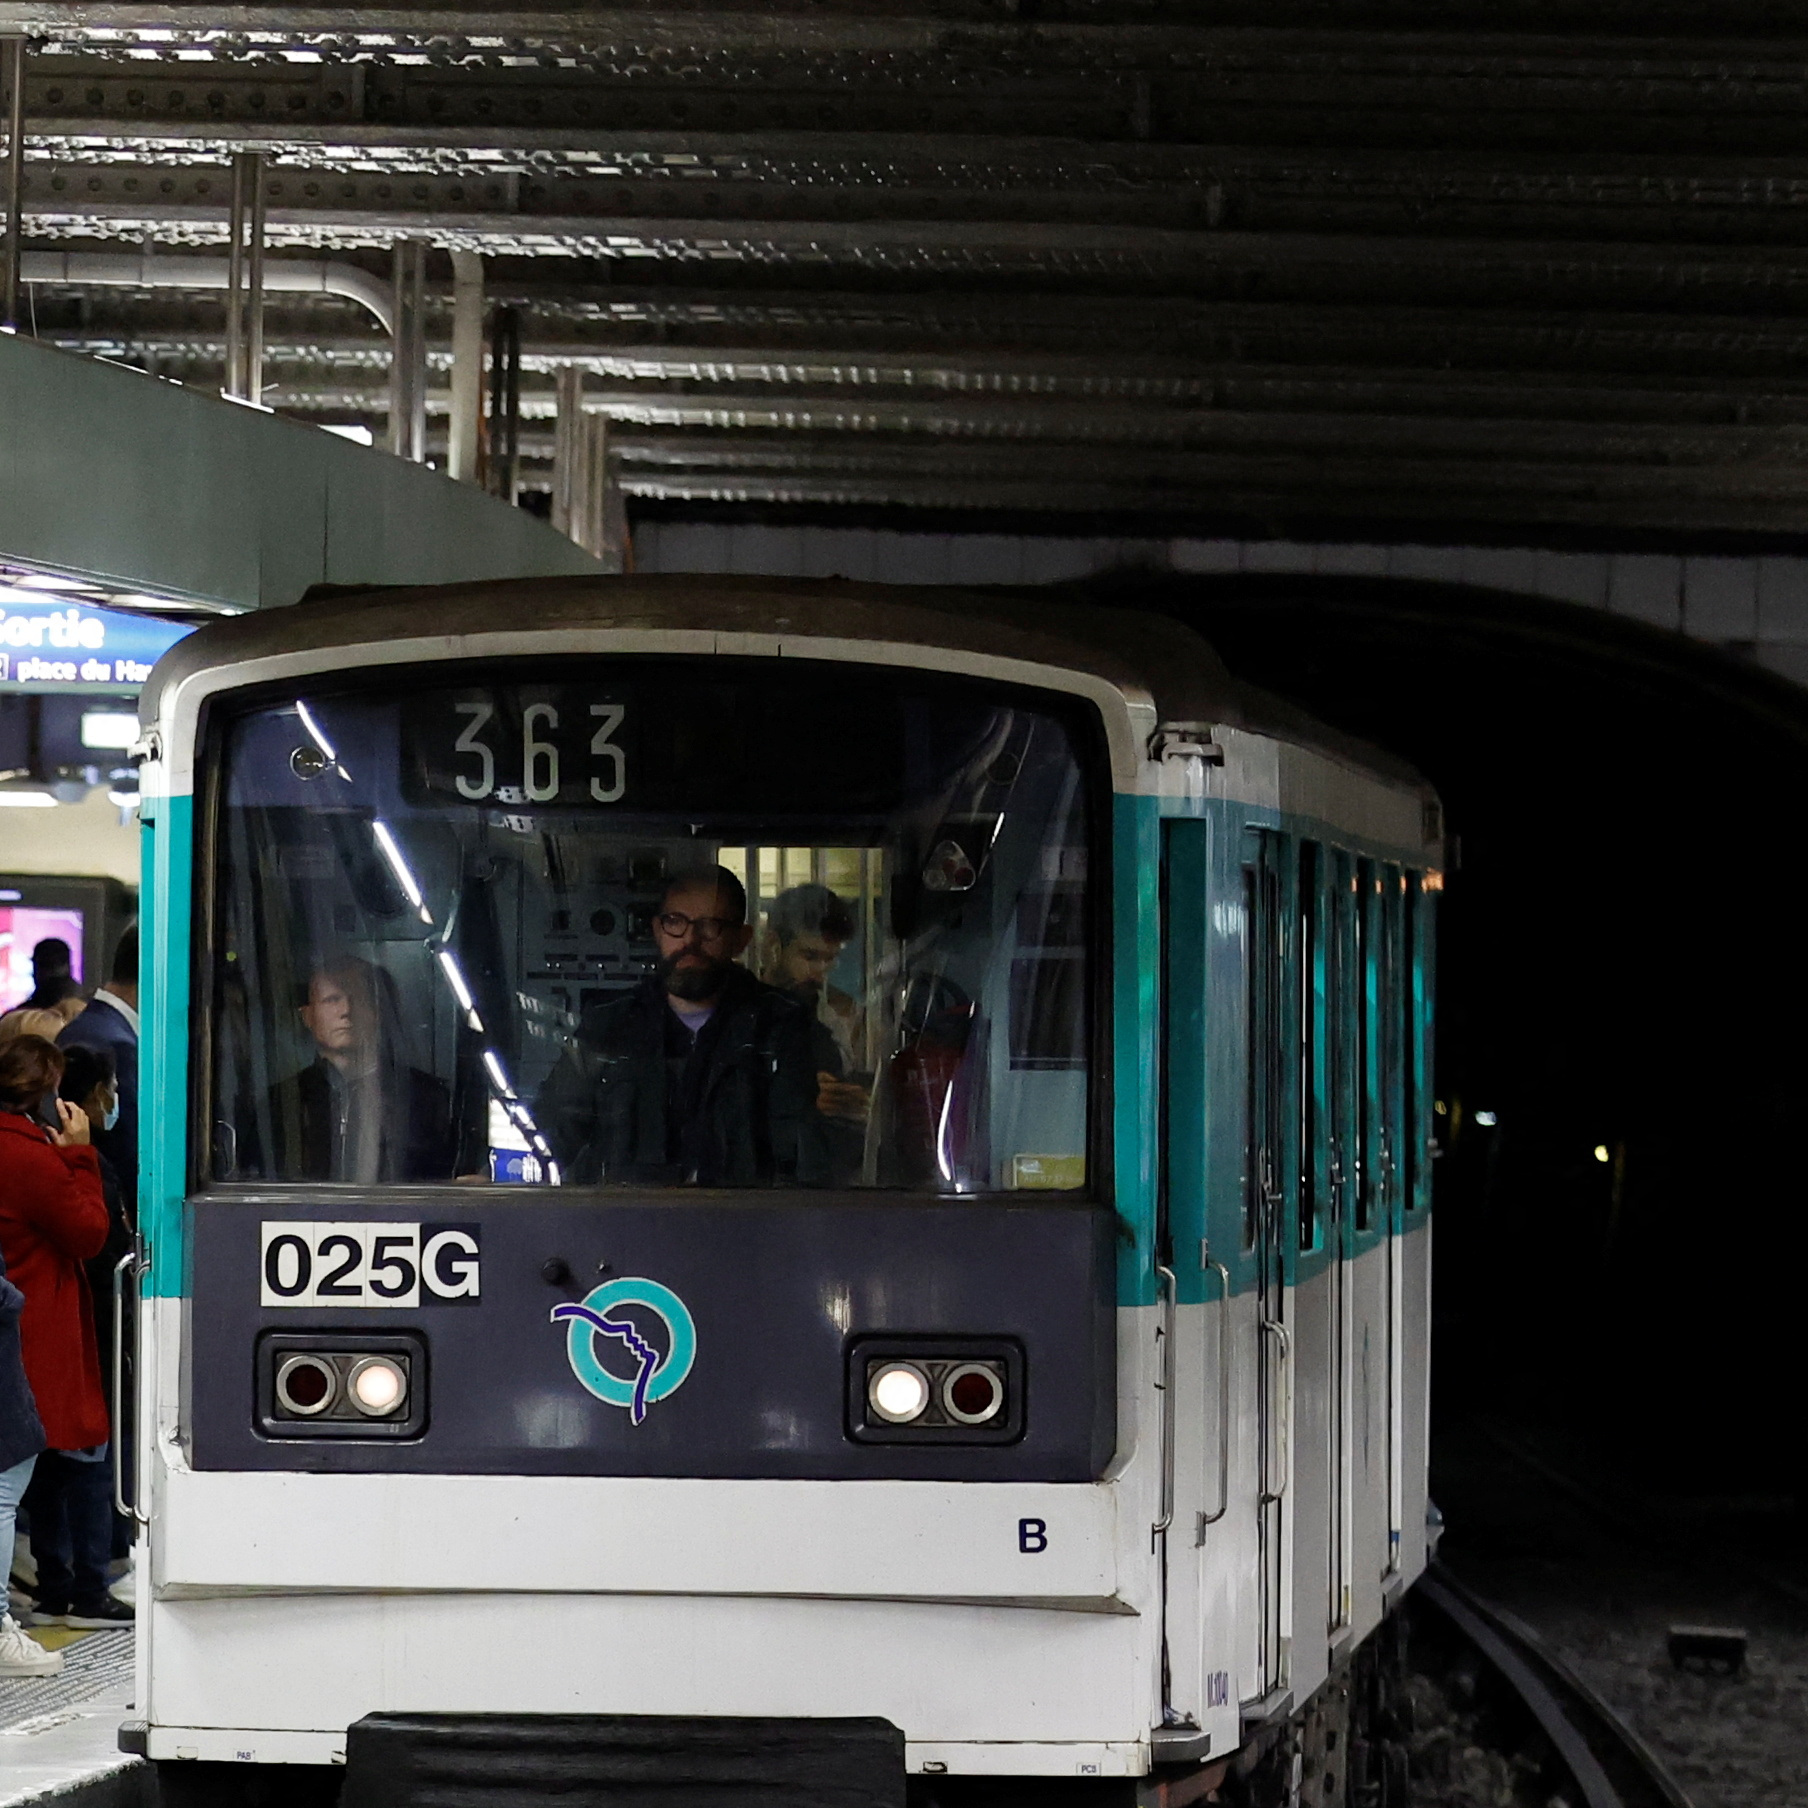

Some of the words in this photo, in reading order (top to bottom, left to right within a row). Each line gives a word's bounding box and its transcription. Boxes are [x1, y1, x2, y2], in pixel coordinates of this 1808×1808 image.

[16, 656, 78, 684] place
[80, 658, 112, 682] du
[454, 702, 627, 803] 363
[264, 1229, 481, 1299] 025G
[1018, 1517, 1048, 1554] B
